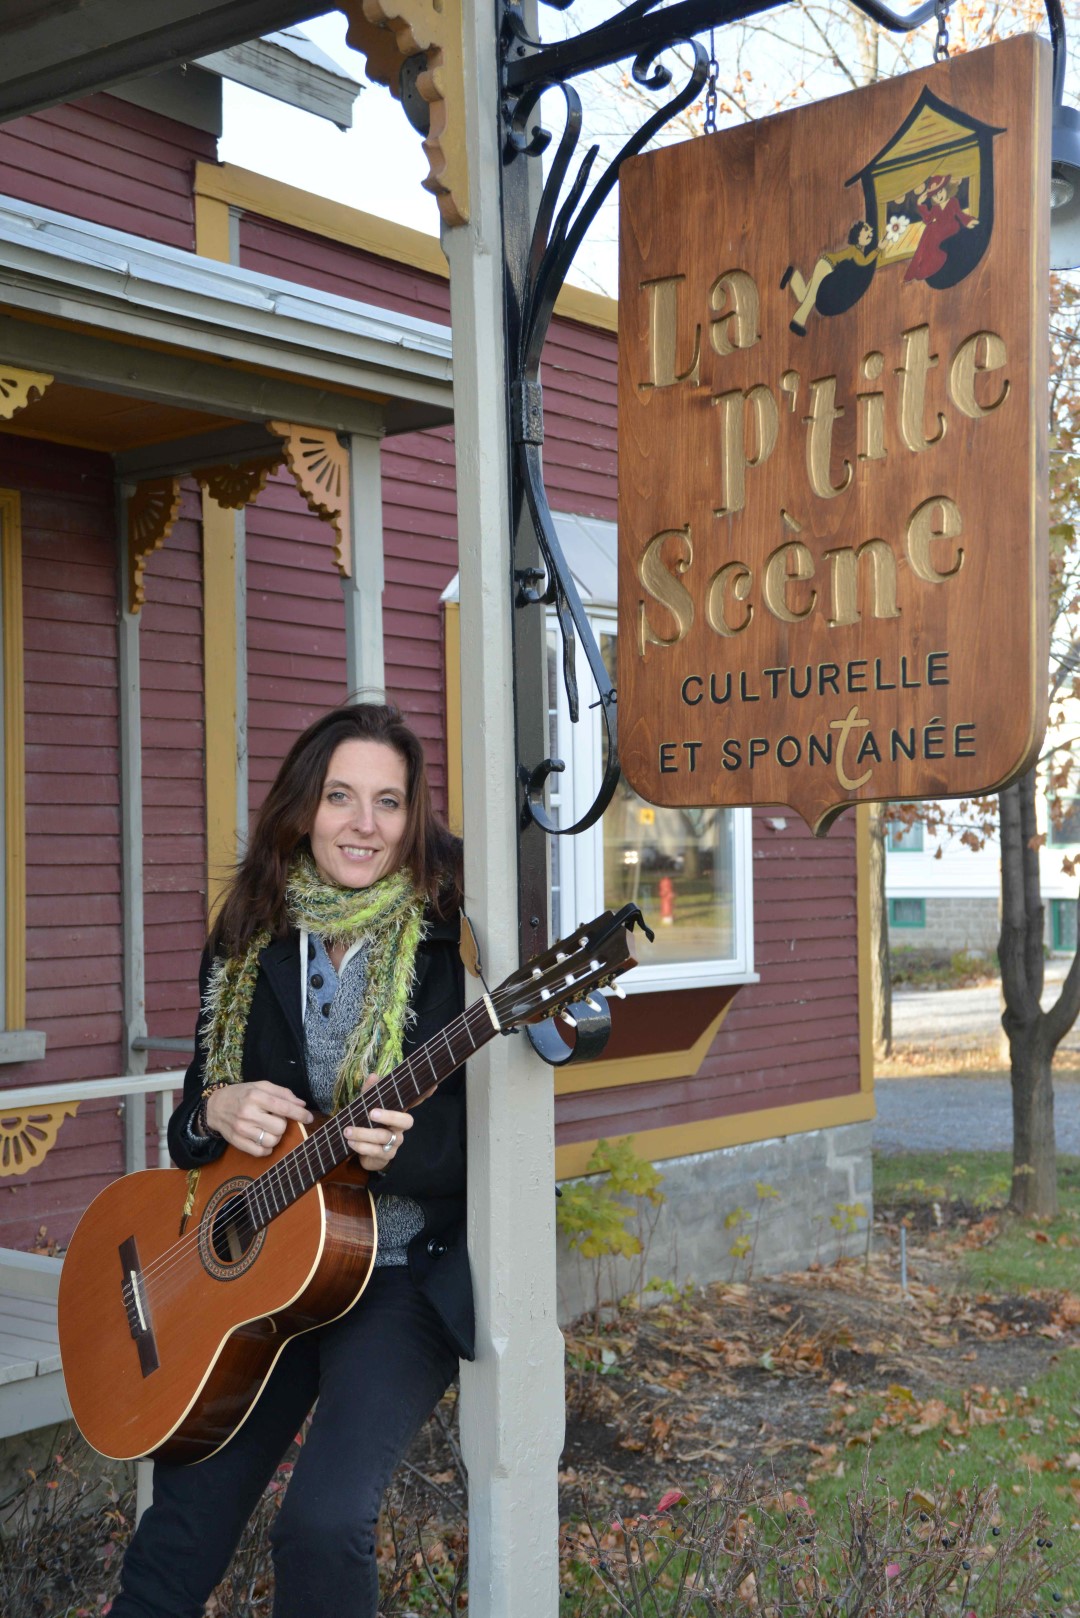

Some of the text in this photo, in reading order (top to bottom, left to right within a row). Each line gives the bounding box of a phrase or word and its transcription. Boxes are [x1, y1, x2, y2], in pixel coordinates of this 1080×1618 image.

[638, 268, 761, 391] La
[638, 495, 965, 656] Scène
[681, 651, 950, 706] CULTURELLE
[658, 742, 702, 773] ET
